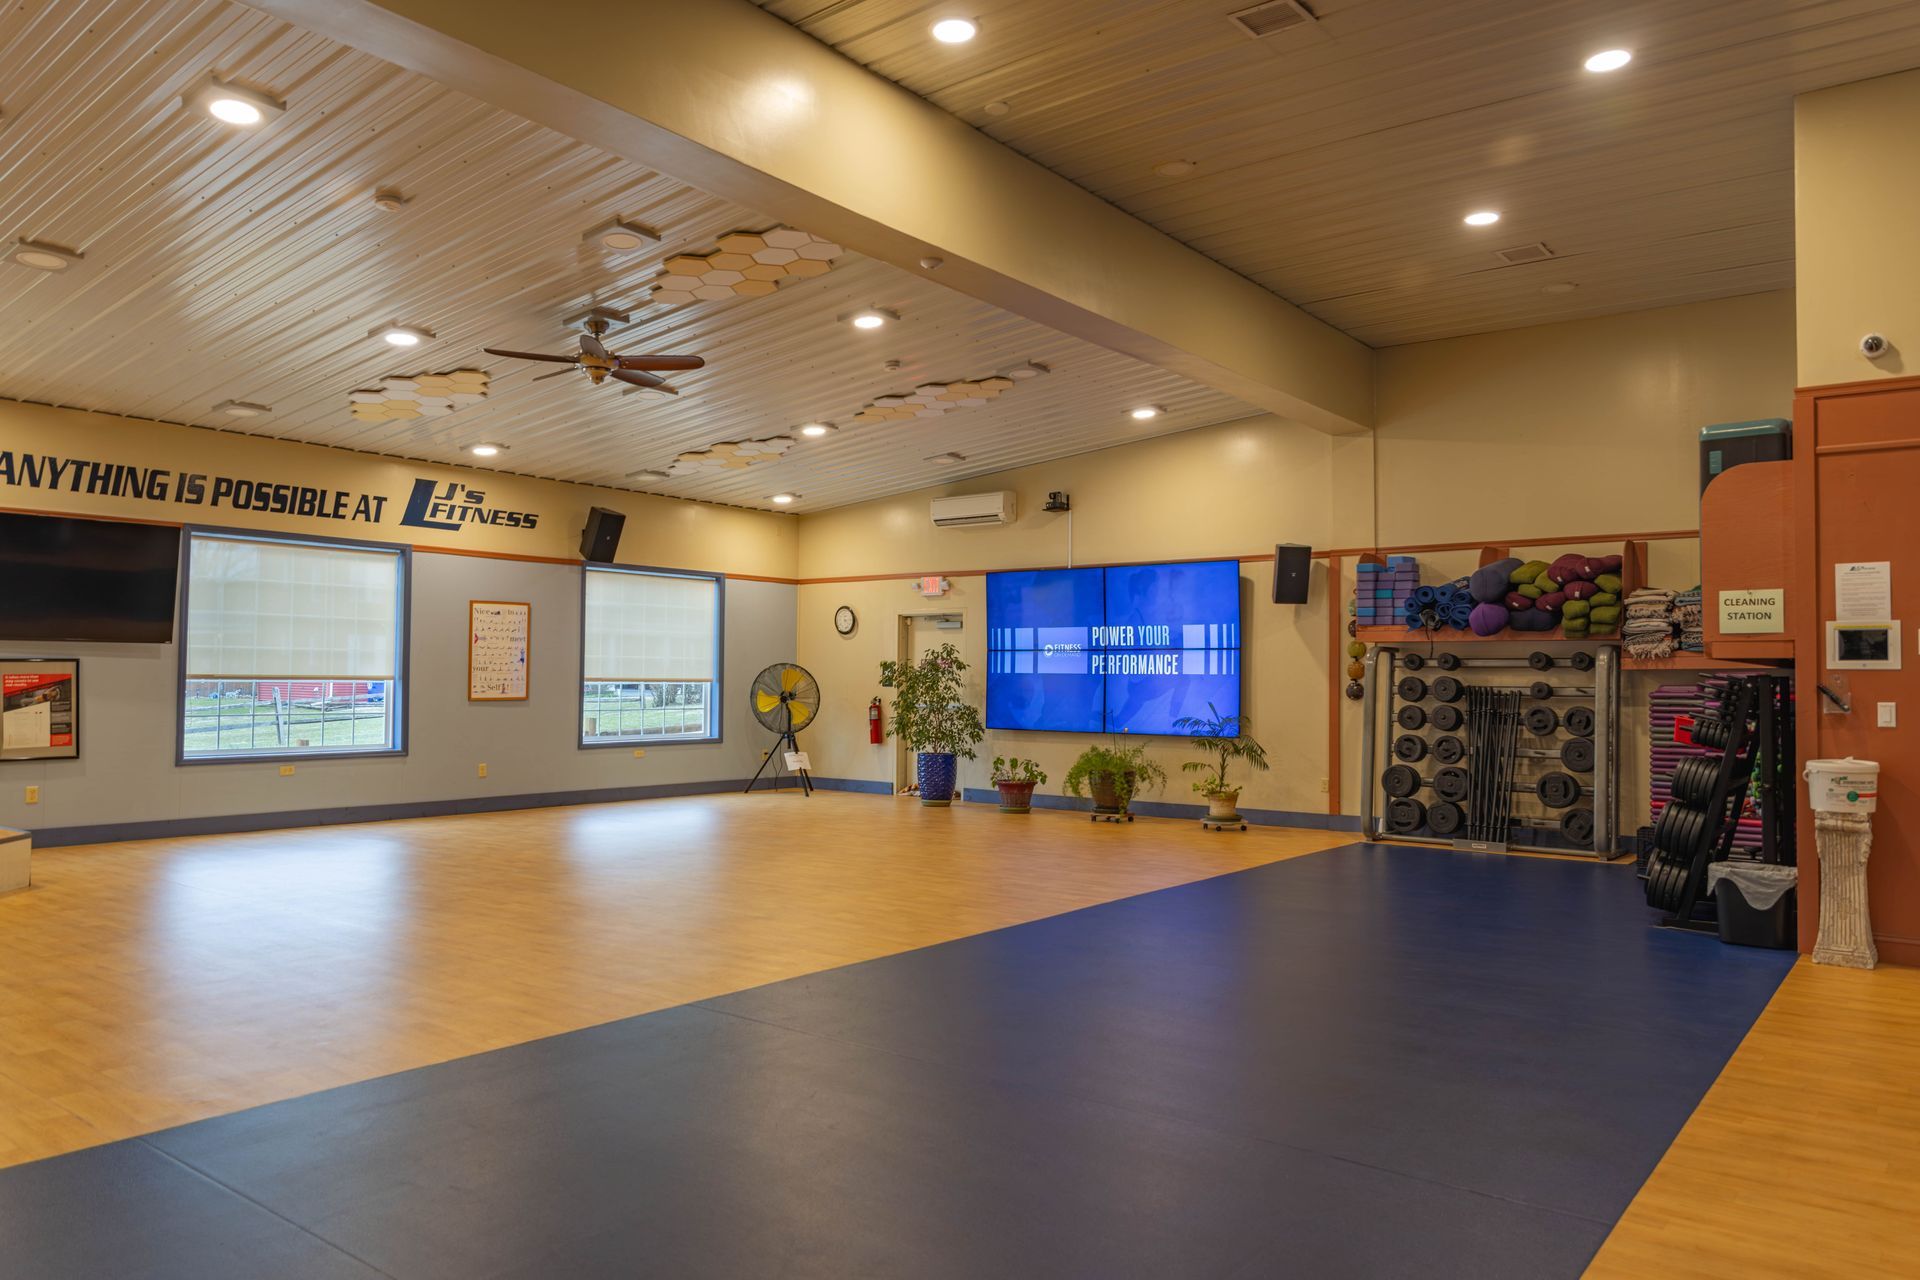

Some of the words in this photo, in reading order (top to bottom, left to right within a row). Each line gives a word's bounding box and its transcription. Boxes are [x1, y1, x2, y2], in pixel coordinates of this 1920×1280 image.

[0, 451, 170, 501] ANYTHING
[174, 472, 207, 504] IS
[210, 477, 350, 519] POSSIBLE
[352, 494, 387, 523] AT
[429, 502, 539, 529] FITNESS
[1724, 597, 1776, 606] CLEANING
[474, 607, 490, 615] Nice
[1727, 612, 1772, 620] STATION
[1092, 625, 1134, 646] POWER
[1138, 624, 1170, 646] YOUR
[1054, 643, 1081, 652] FITNESS
[1091, 654, 1179, 675] PERFORMANCE
